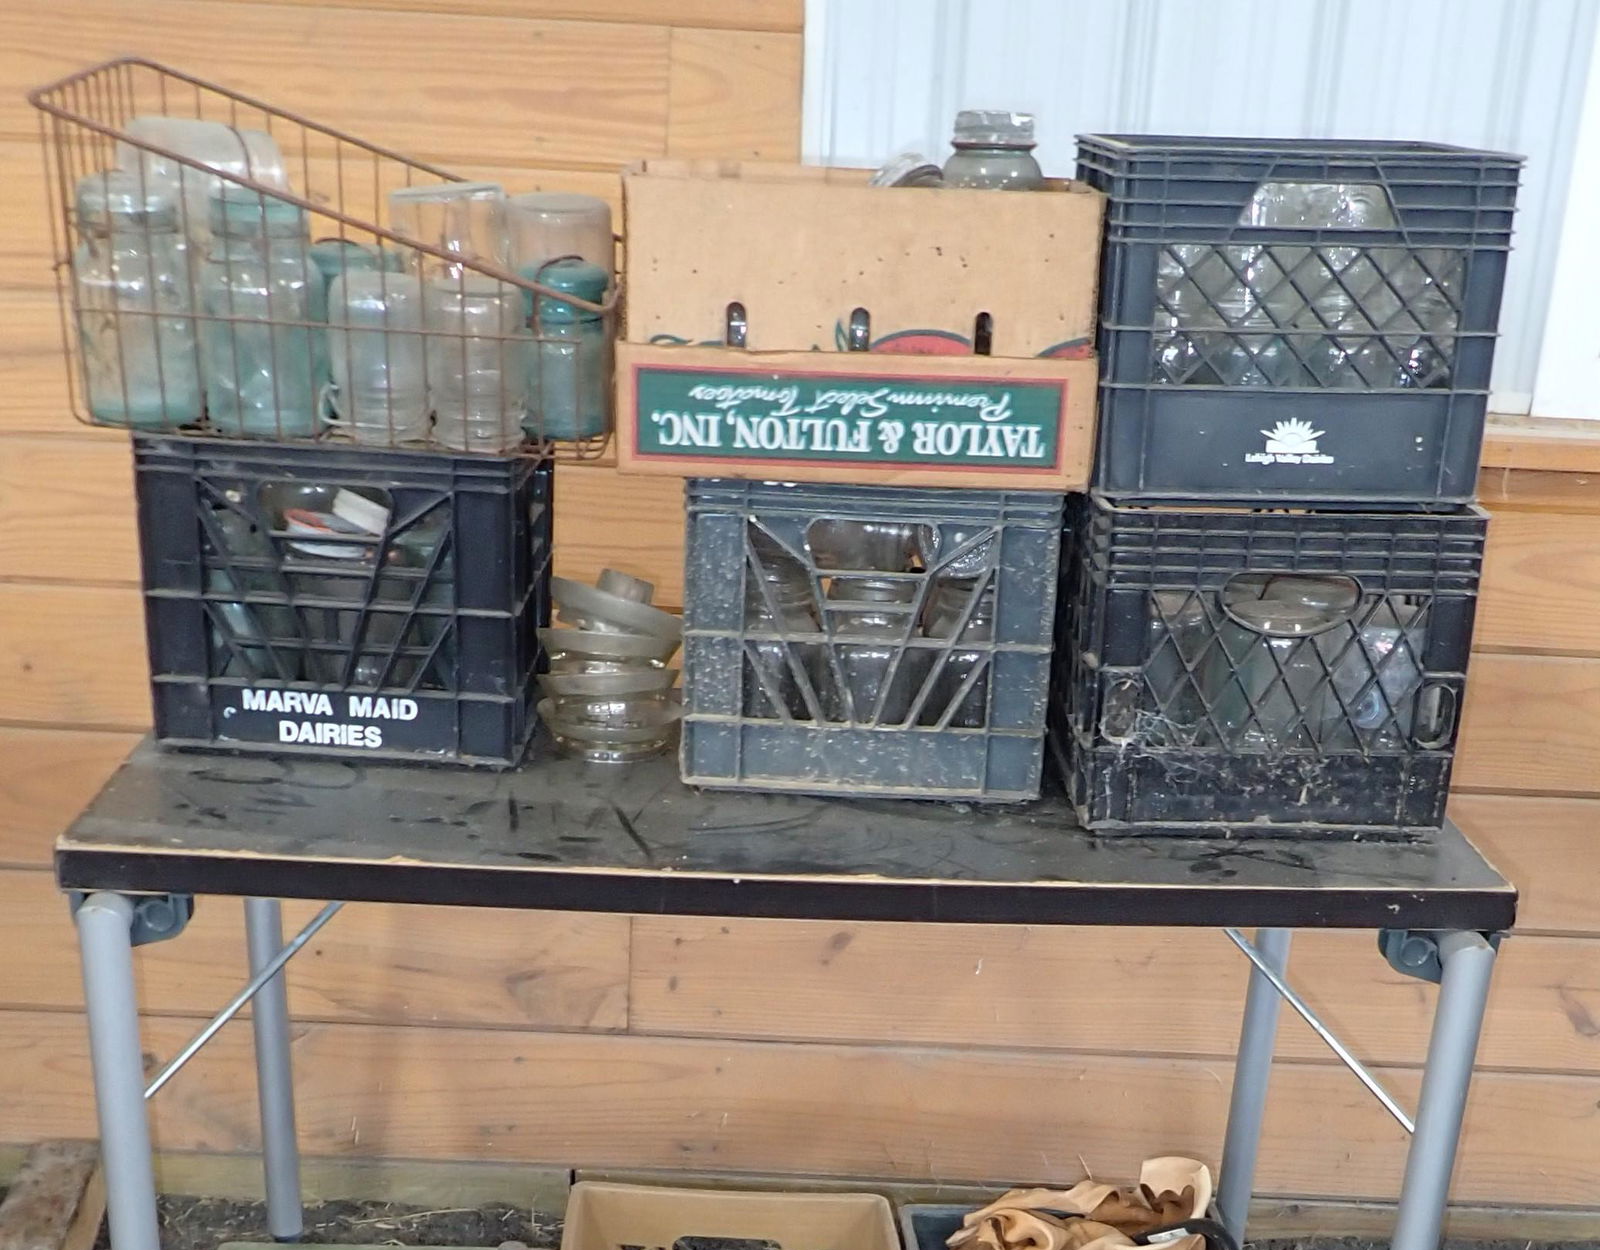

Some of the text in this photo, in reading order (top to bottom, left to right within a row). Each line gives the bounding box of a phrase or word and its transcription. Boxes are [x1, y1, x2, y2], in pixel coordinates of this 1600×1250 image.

[687, 383, 1012, 422] Premium Select Tomatoes
[650, 409, 1045, 458] TAYLOR & FULTON, INC.
[242, 688, 418, 721] MARVA MAID
[279, 720, 383, 748] DAIRIES
